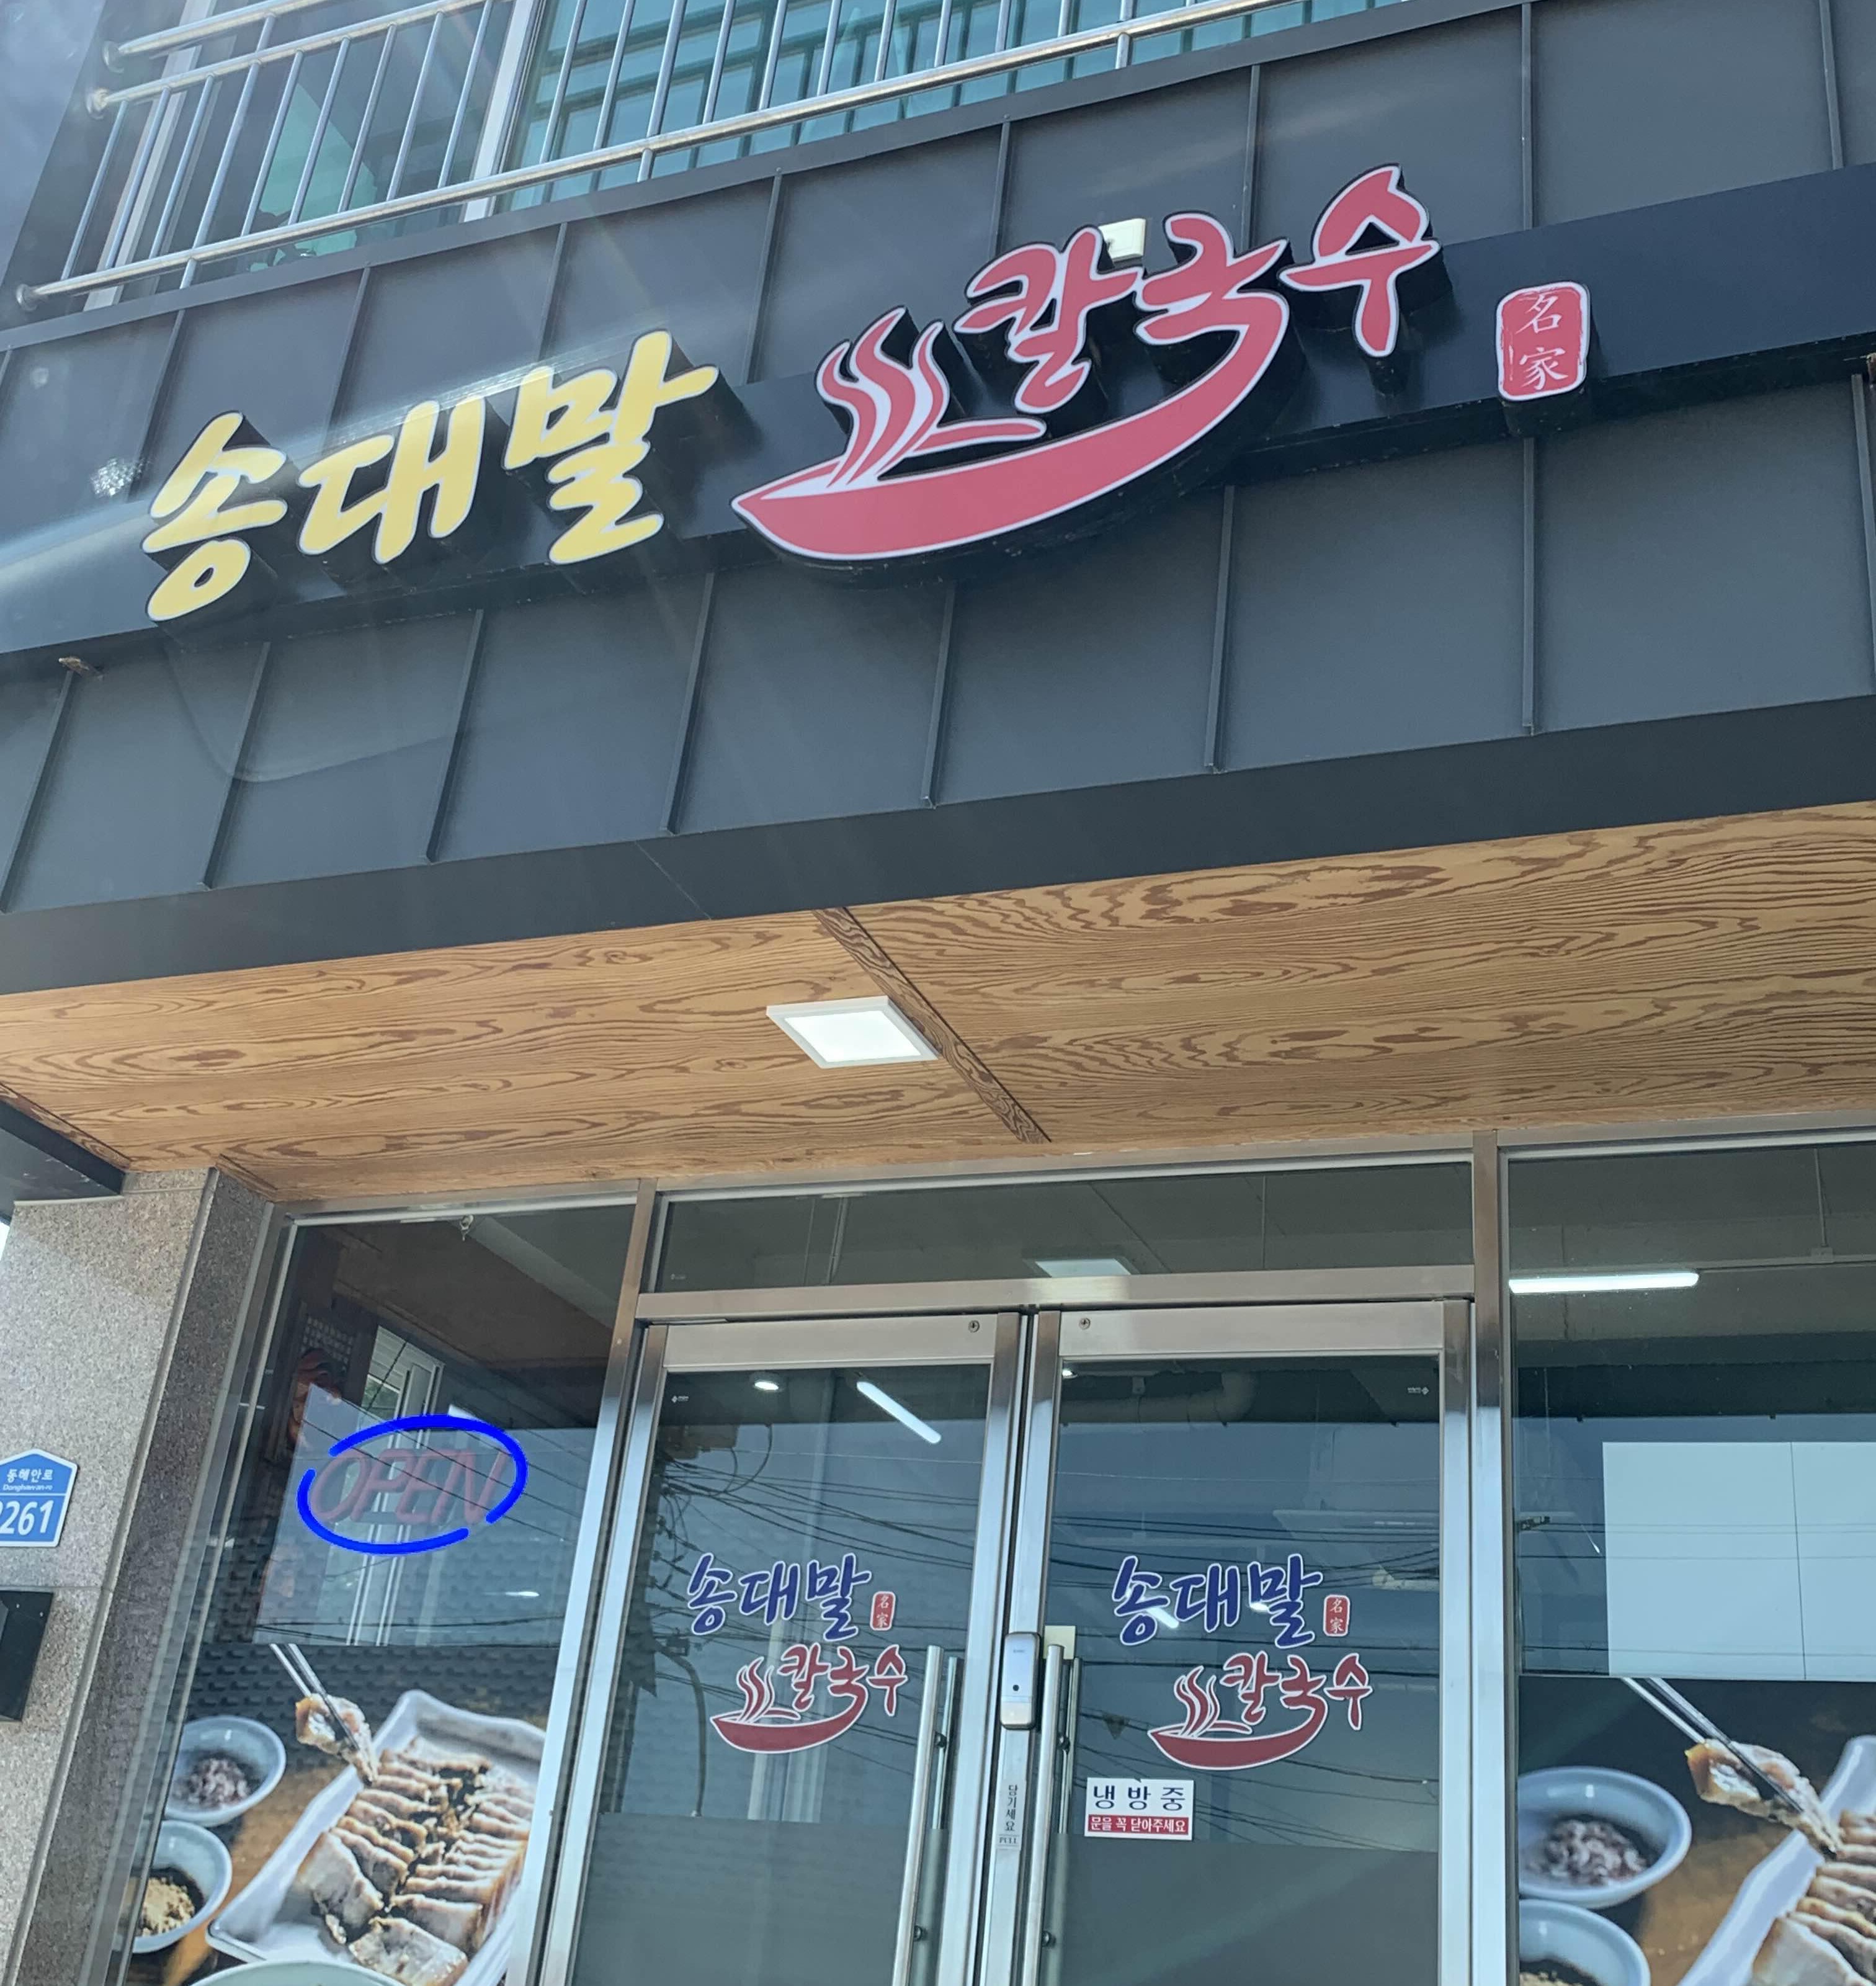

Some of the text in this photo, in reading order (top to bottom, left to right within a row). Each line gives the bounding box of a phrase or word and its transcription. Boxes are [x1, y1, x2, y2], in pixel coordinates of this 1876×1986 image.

[1514, 292, 1571, 392] 名家
[141, 163, 1442, 621] 송대말 칼국수
[6, 1468, 54, 1483] 동해안로
[310, 1447, 511, 1526] OPEN
[0, 1500, 55, 1536] 261
[687, 1552, 872, 1641] 송대말
[1111, 1553, 1323, 1648] 송대말
[1328, 1596, 1346, 1634] 名家
[777, 1642, 908, 1731] 칼국수
[1219, 1650, 1373, 1742] 칼국수
[1005, 1784, 1018, 1832] 당기세요
[1091, 1815, 1187, 1833] 문을 꼭 닫아주세요
